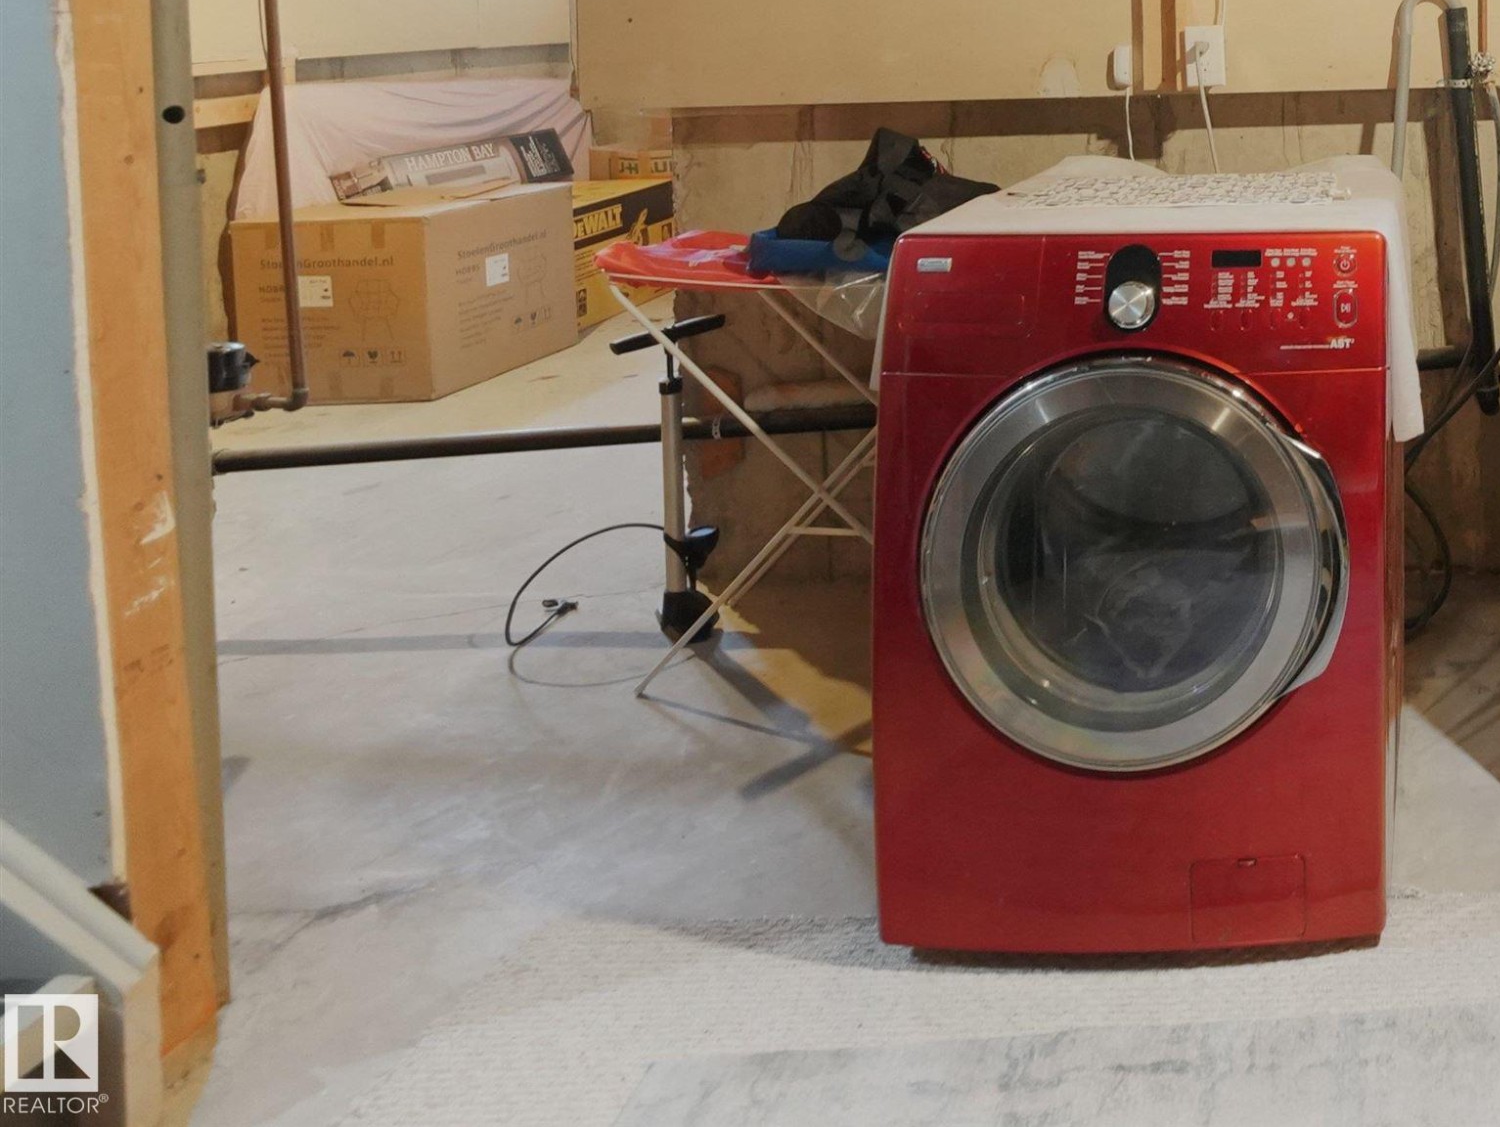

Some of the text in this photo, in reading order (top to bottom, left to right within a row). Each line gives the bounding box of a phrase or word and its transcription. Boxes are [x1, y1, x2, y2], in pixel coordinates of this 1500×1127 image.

[404, 145, 473, 172] HAMPTON
[473, 142, 497, 162] BAY
[259, 255, 394, 270] StoenGroothandel.nl
